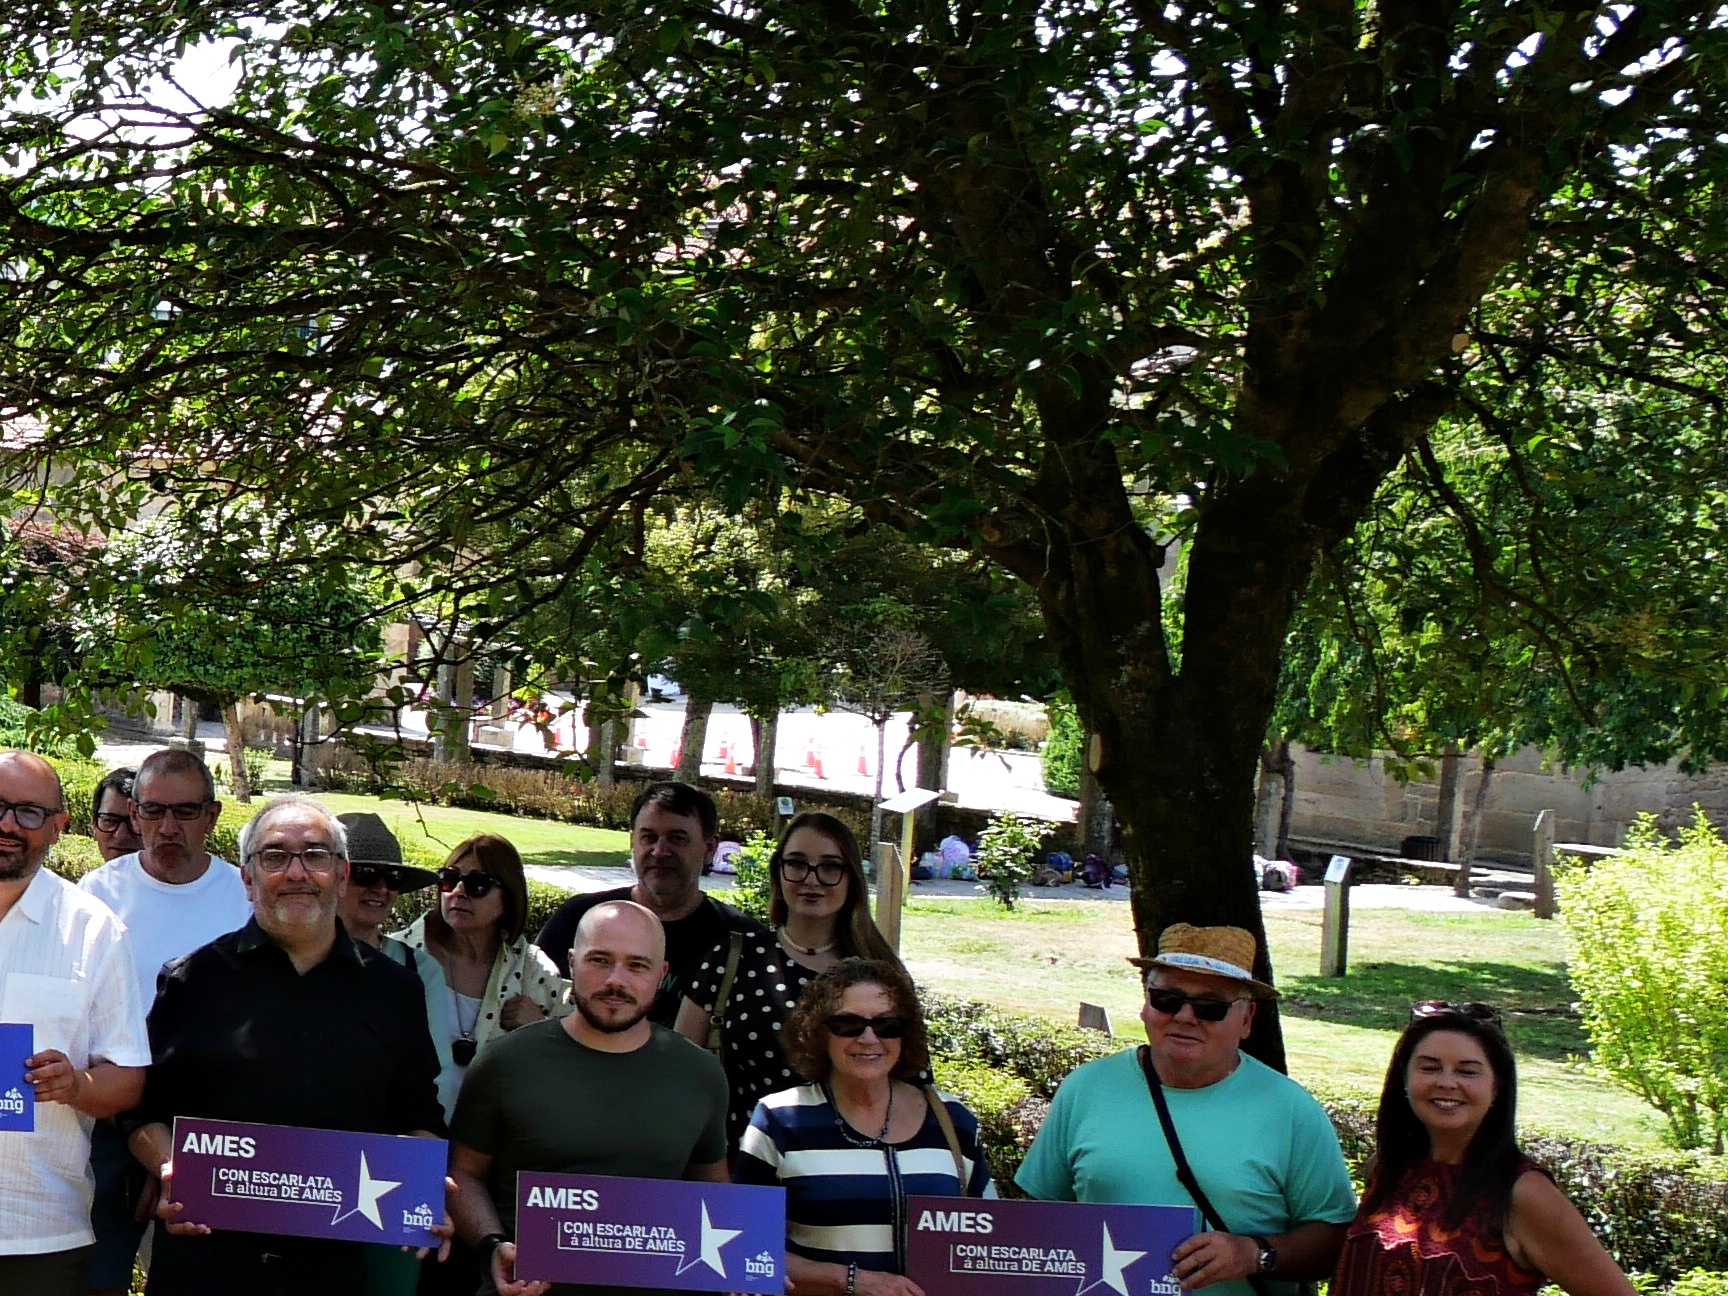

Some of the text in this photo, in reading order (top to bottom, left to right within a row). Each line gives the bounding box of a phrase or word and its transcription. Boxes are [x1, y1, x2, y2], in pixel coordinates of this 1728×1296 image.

[182, 1132, 255, 1158] AMES
[219, 1168, 333, 1189] CON ESCARLATA
[226, 1180, 342, 1202] á altura DE AMES
[527, 1187, 598, 1211] AMES
[403, 1210, 433, 1230] bng
[917, 1211, 993, 1234] AMES
[564, 1222, 676, 1239] CON ESCARLATA
[571, 1234, 685, 1252] á altura DE AMES
[957, 1245, 1076, 1261] CON ESCARLATA
[745, 1258, 774, 1277] bng
[964, 1256, 1086, 1274] á altura DE AMES
